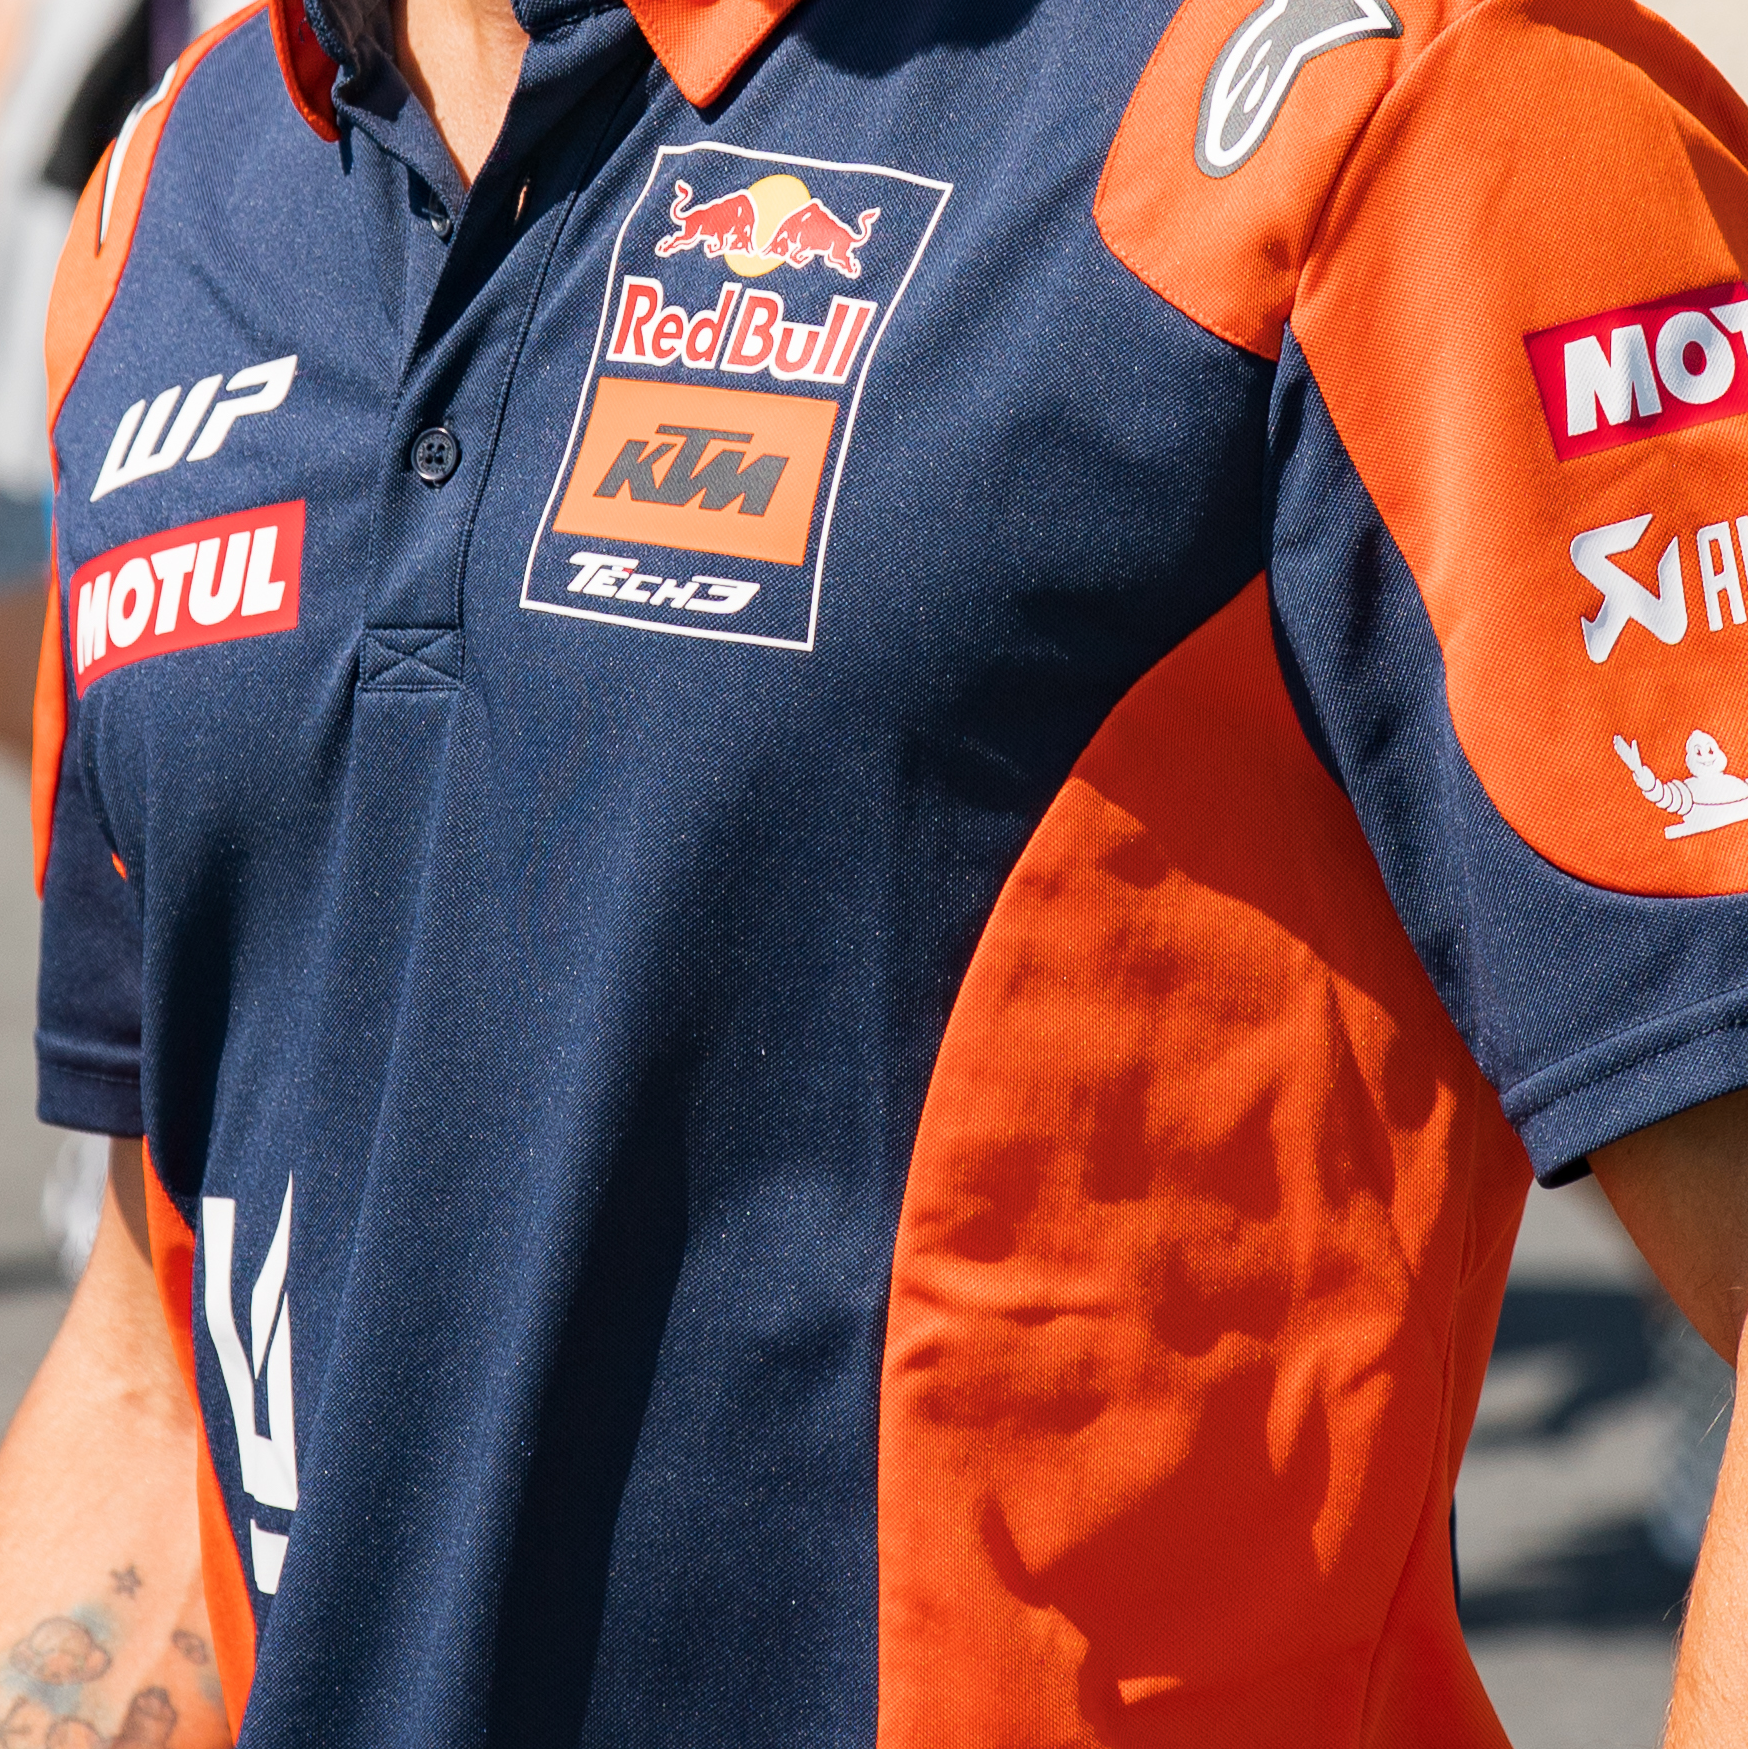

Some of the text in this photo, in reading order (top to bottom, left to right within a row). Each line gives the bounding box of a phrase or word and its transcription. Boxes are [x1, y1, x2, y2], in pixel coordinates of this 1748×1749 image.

[606, 275, 878, 384] Red Bull
[89, 354, 298, 502] WP
[593, 423, 789, 518] KTM
[77, 525, 286, 675] MOTUL
